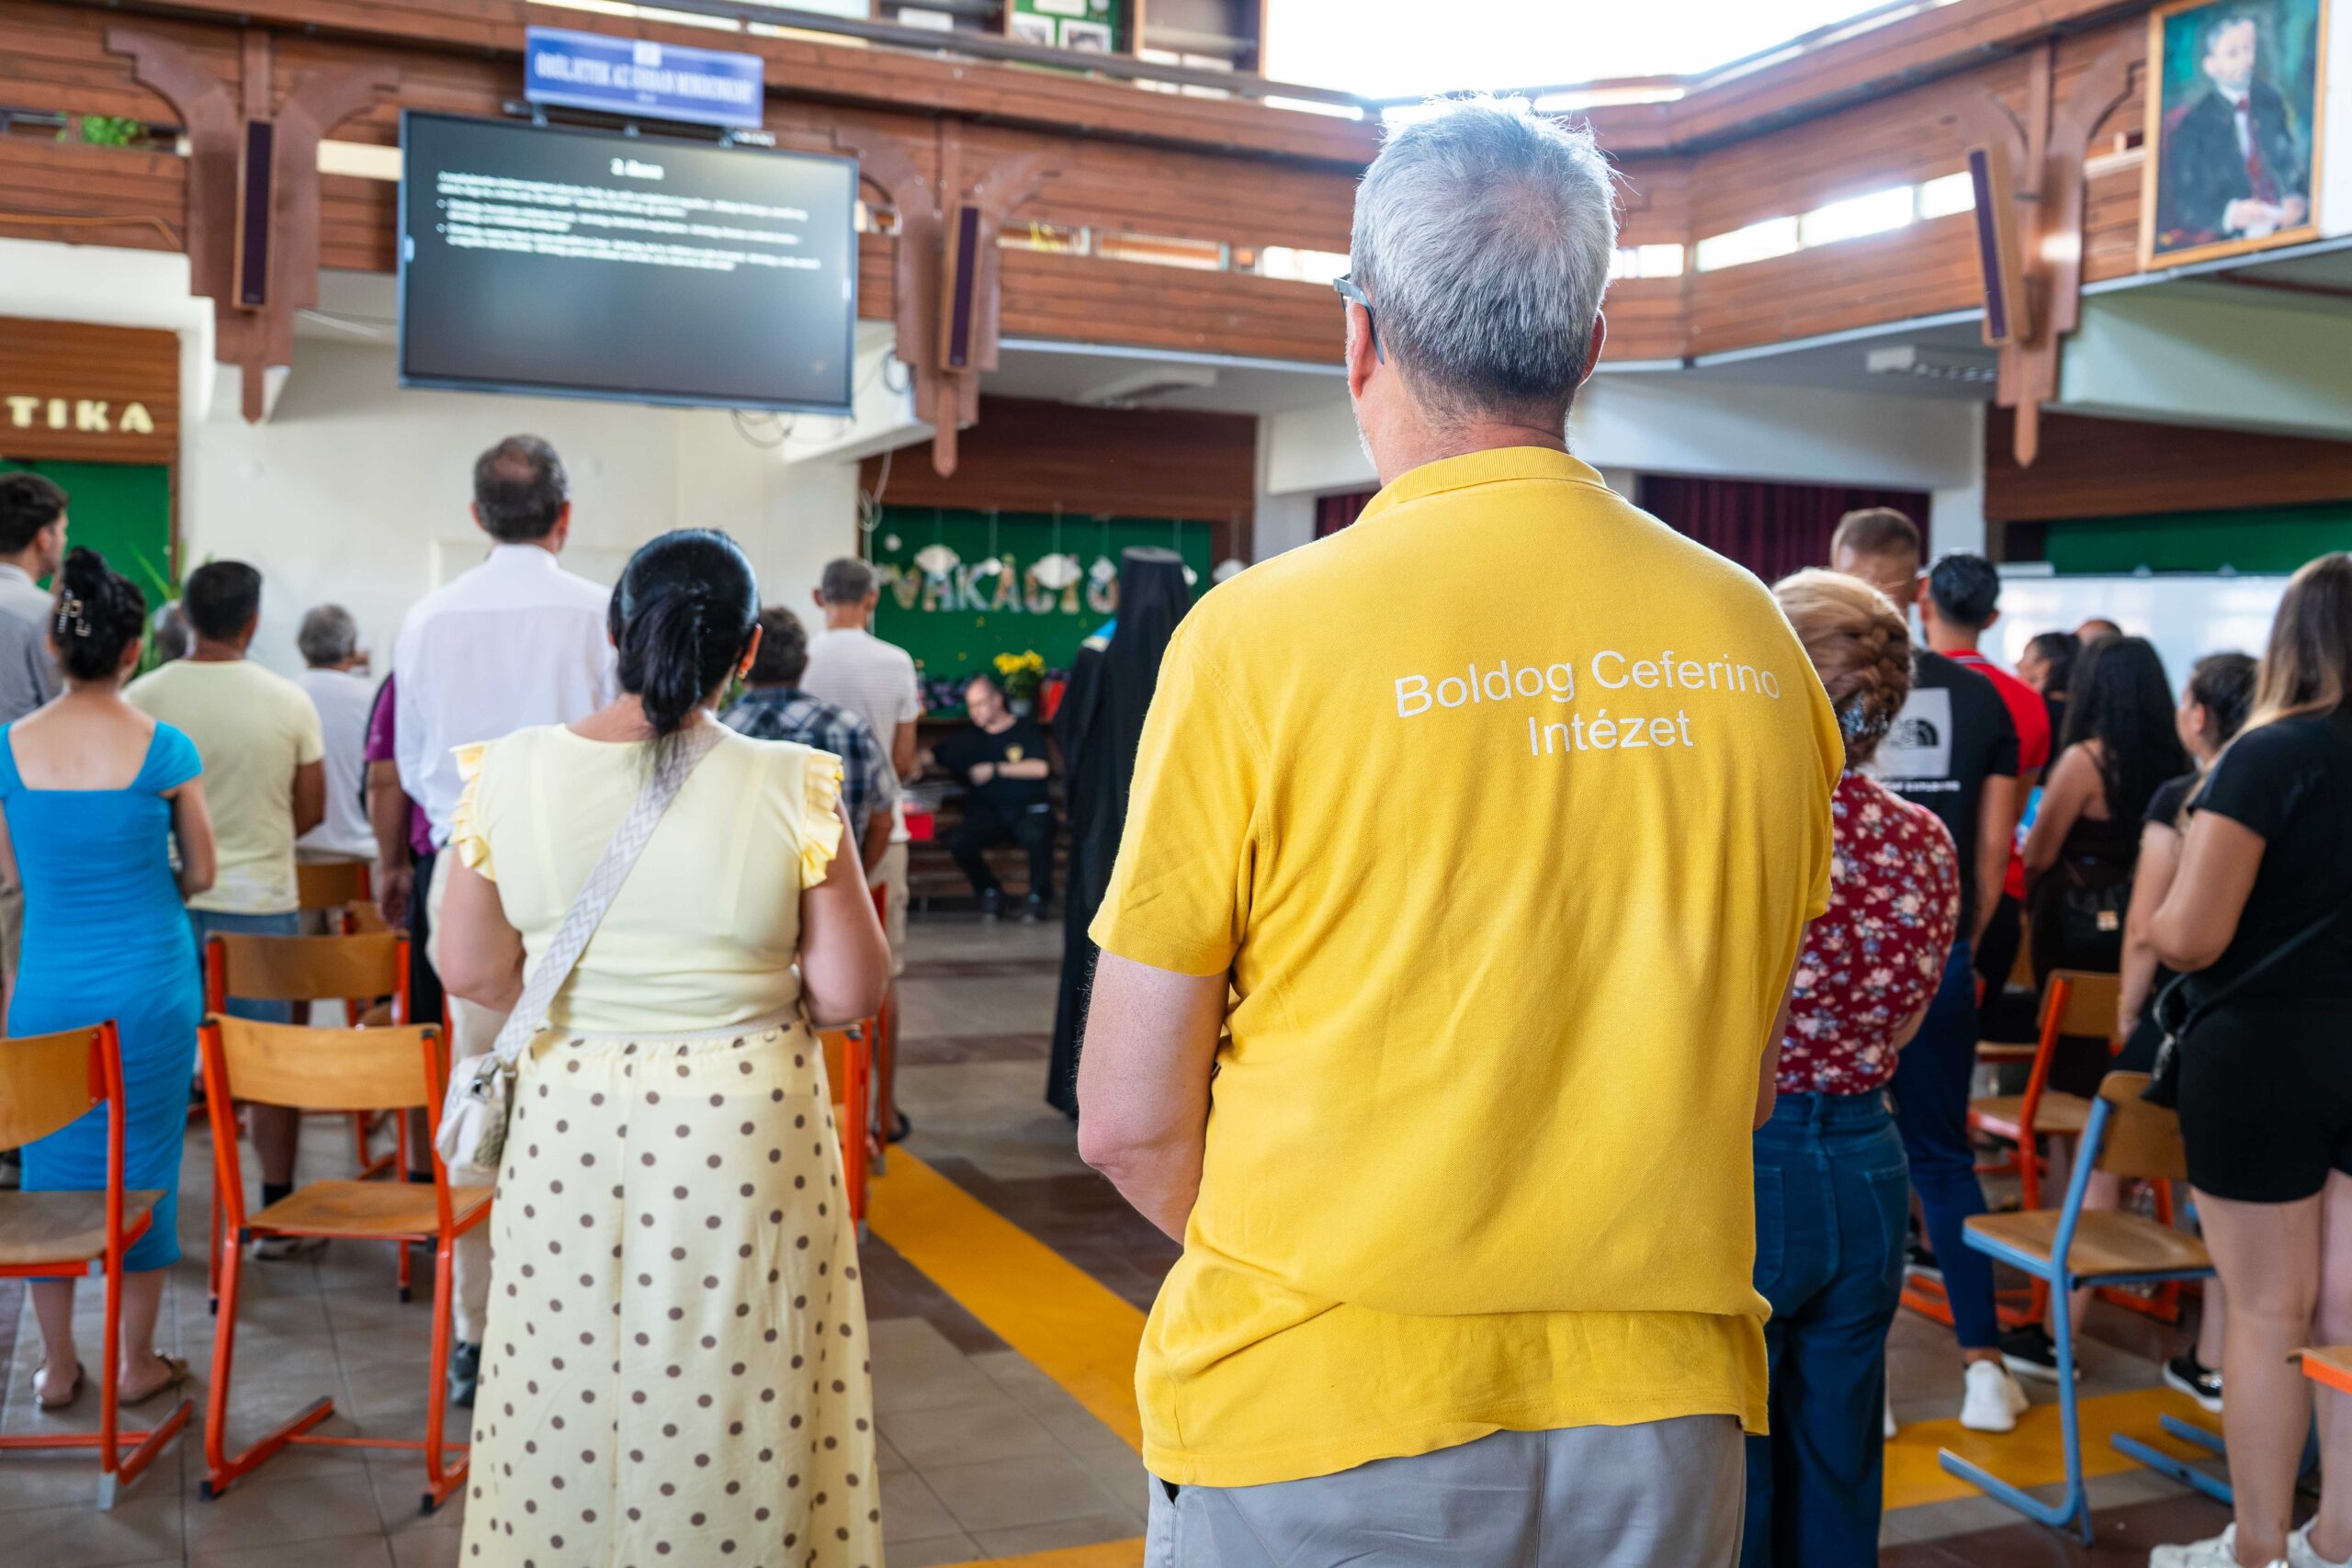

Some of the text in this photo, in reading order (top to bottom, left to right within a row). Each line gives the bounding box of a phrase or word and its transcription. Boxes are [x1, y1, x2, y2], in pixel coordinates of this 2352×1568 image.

[5, 395, 155, 434] TIKA
[1394, 649, 1781, 718] Boldog Ceferino
[1527, 708, 1694, 756] Intézet
